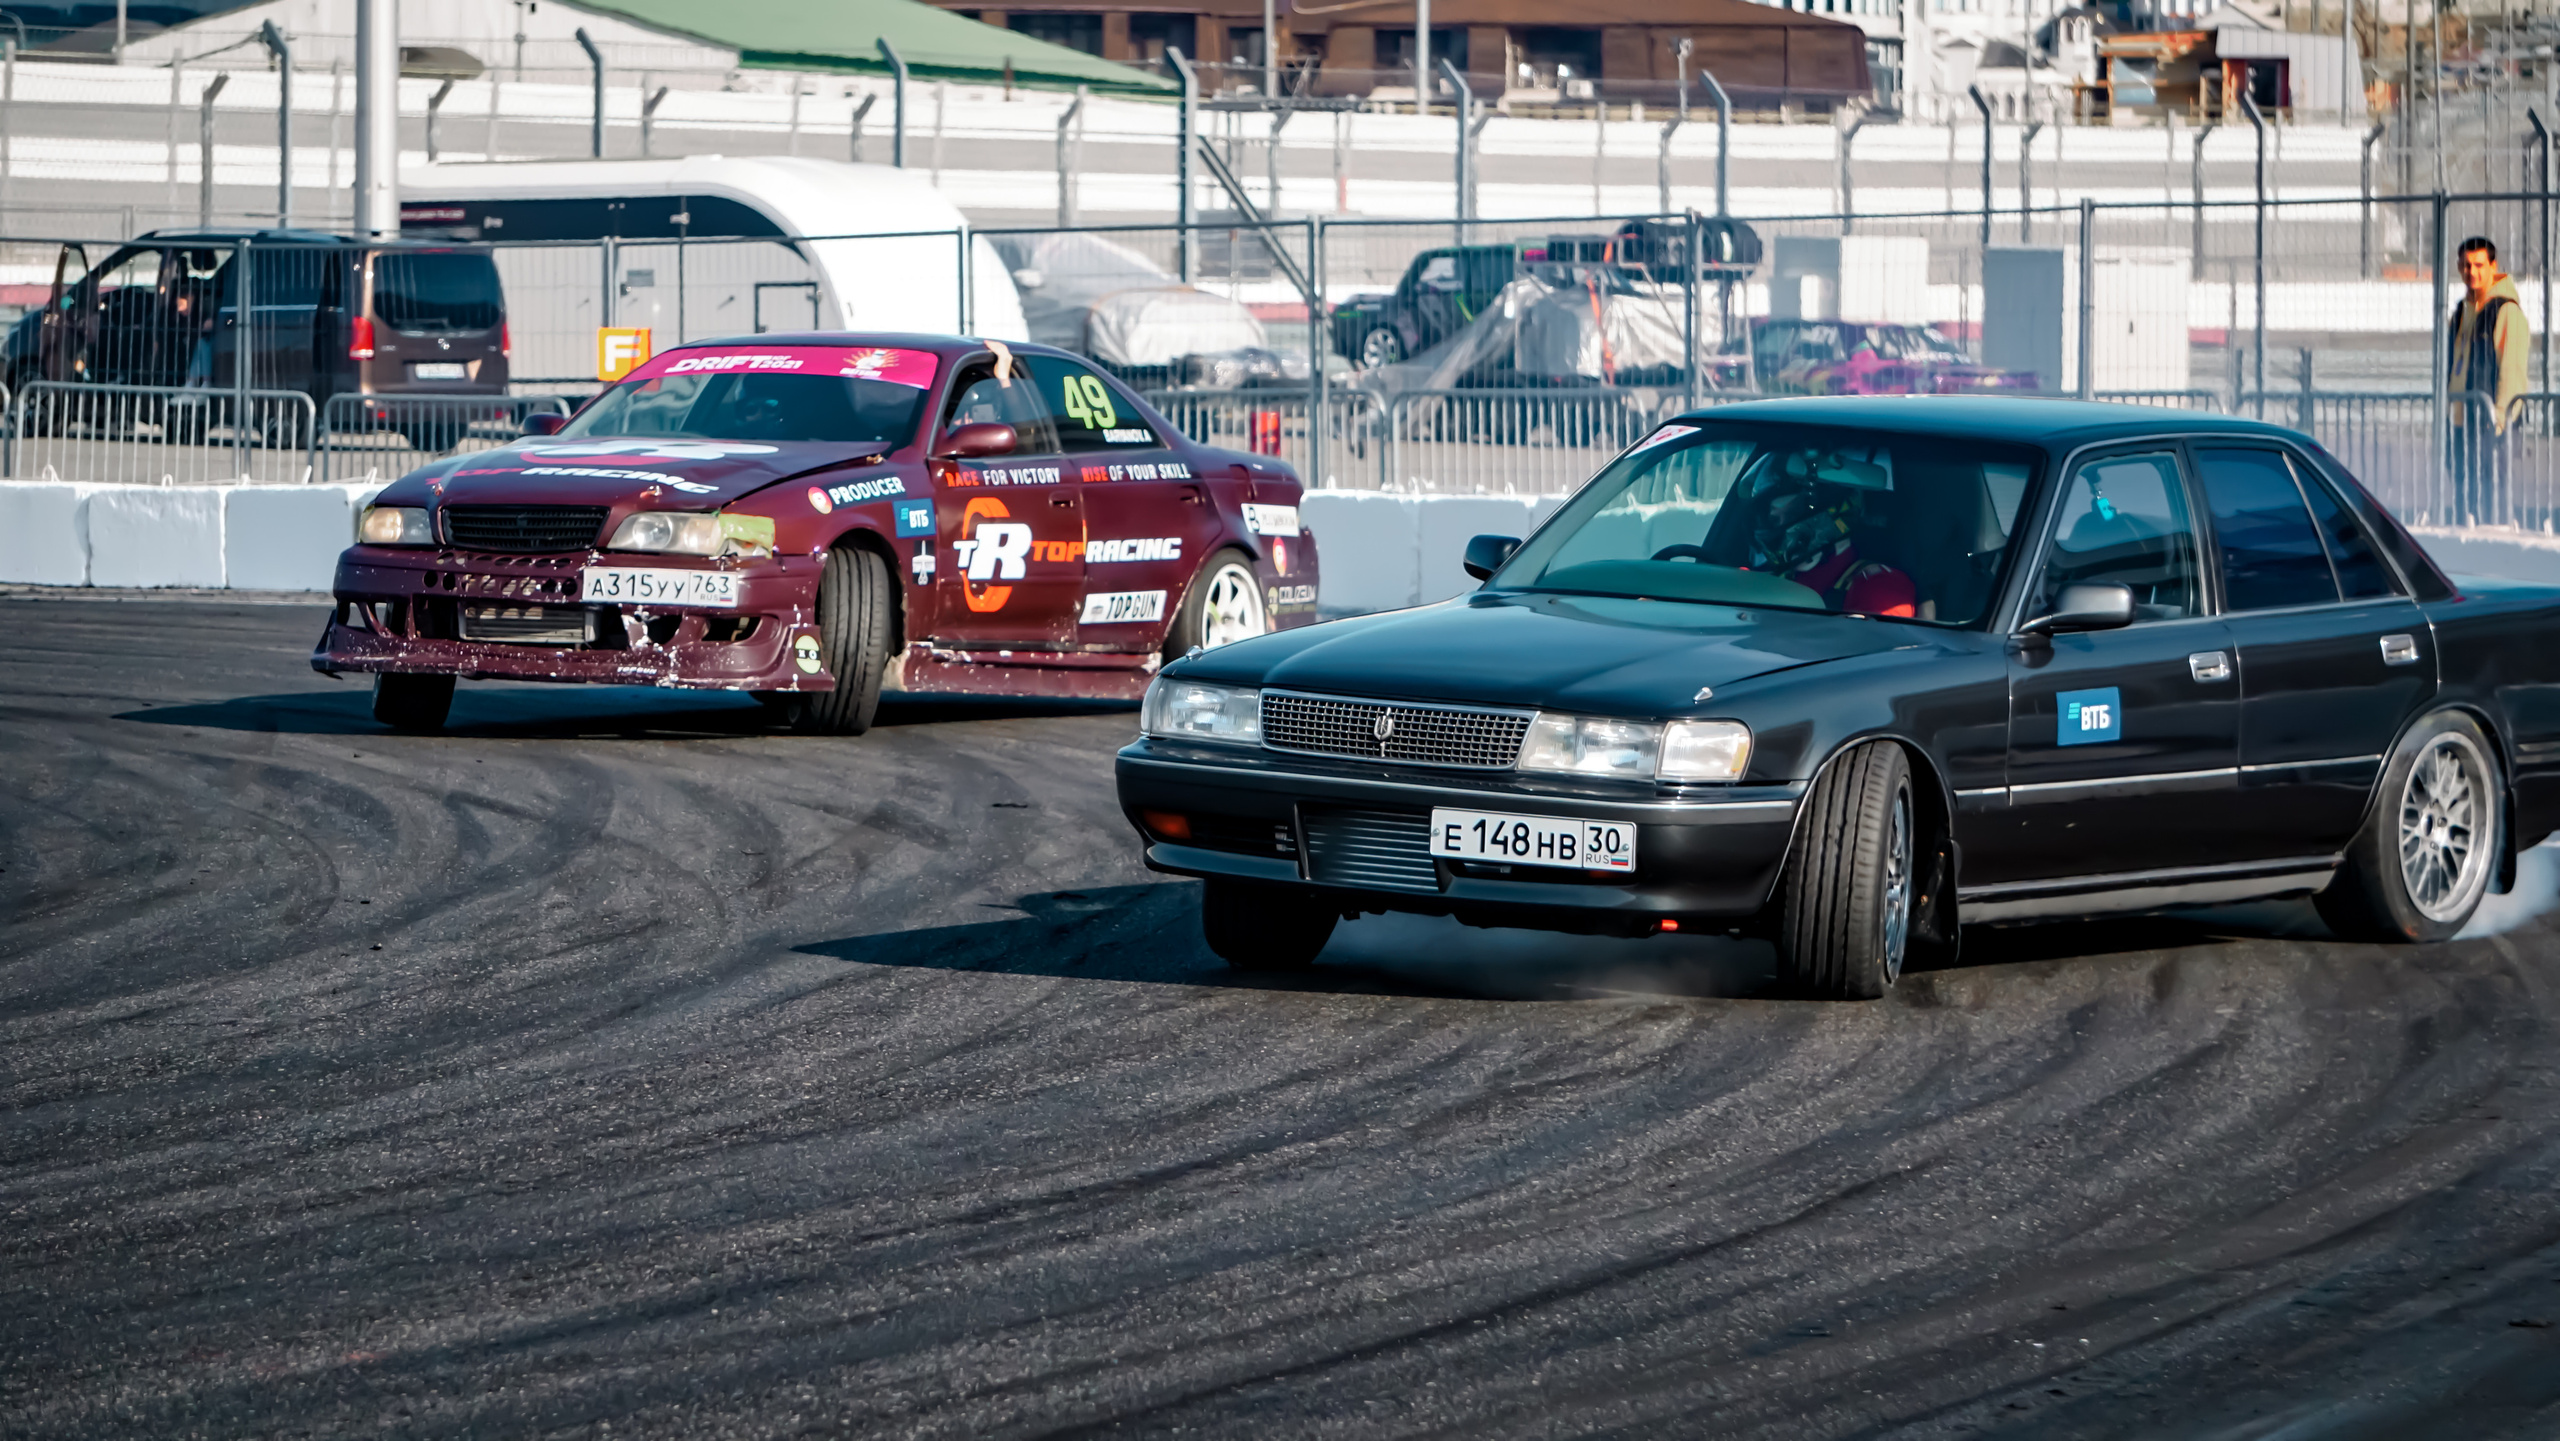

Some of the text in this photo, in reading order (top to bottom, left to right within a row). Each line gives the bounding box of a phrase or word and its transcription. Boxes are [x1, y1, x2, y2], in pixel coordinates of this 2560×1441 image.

[605, 335, 641, 372] F
[664, 355, 772, 373] DRIFT
[758, 360, 804, 370] 2021
[1063, 375, 1116, 429] 49
[520, 466, 720, 495] RACING
[945, 467, 1060, 487] RACE FOR VICTORY
[1081, 463, 1191, 483] RISE OF YOUR SKILL
[828, 476, 906, 505] PRODUCER
[909, 509, 929, 528] ВТБ
[693, 575, 730, 593] 763
[700, 593, 719, 601] RUS
[2081, 704, 2109, 731] ВТБ
[1588, 826, 1620, 854] 30
[1585, 853, 1610, 864] RUS
